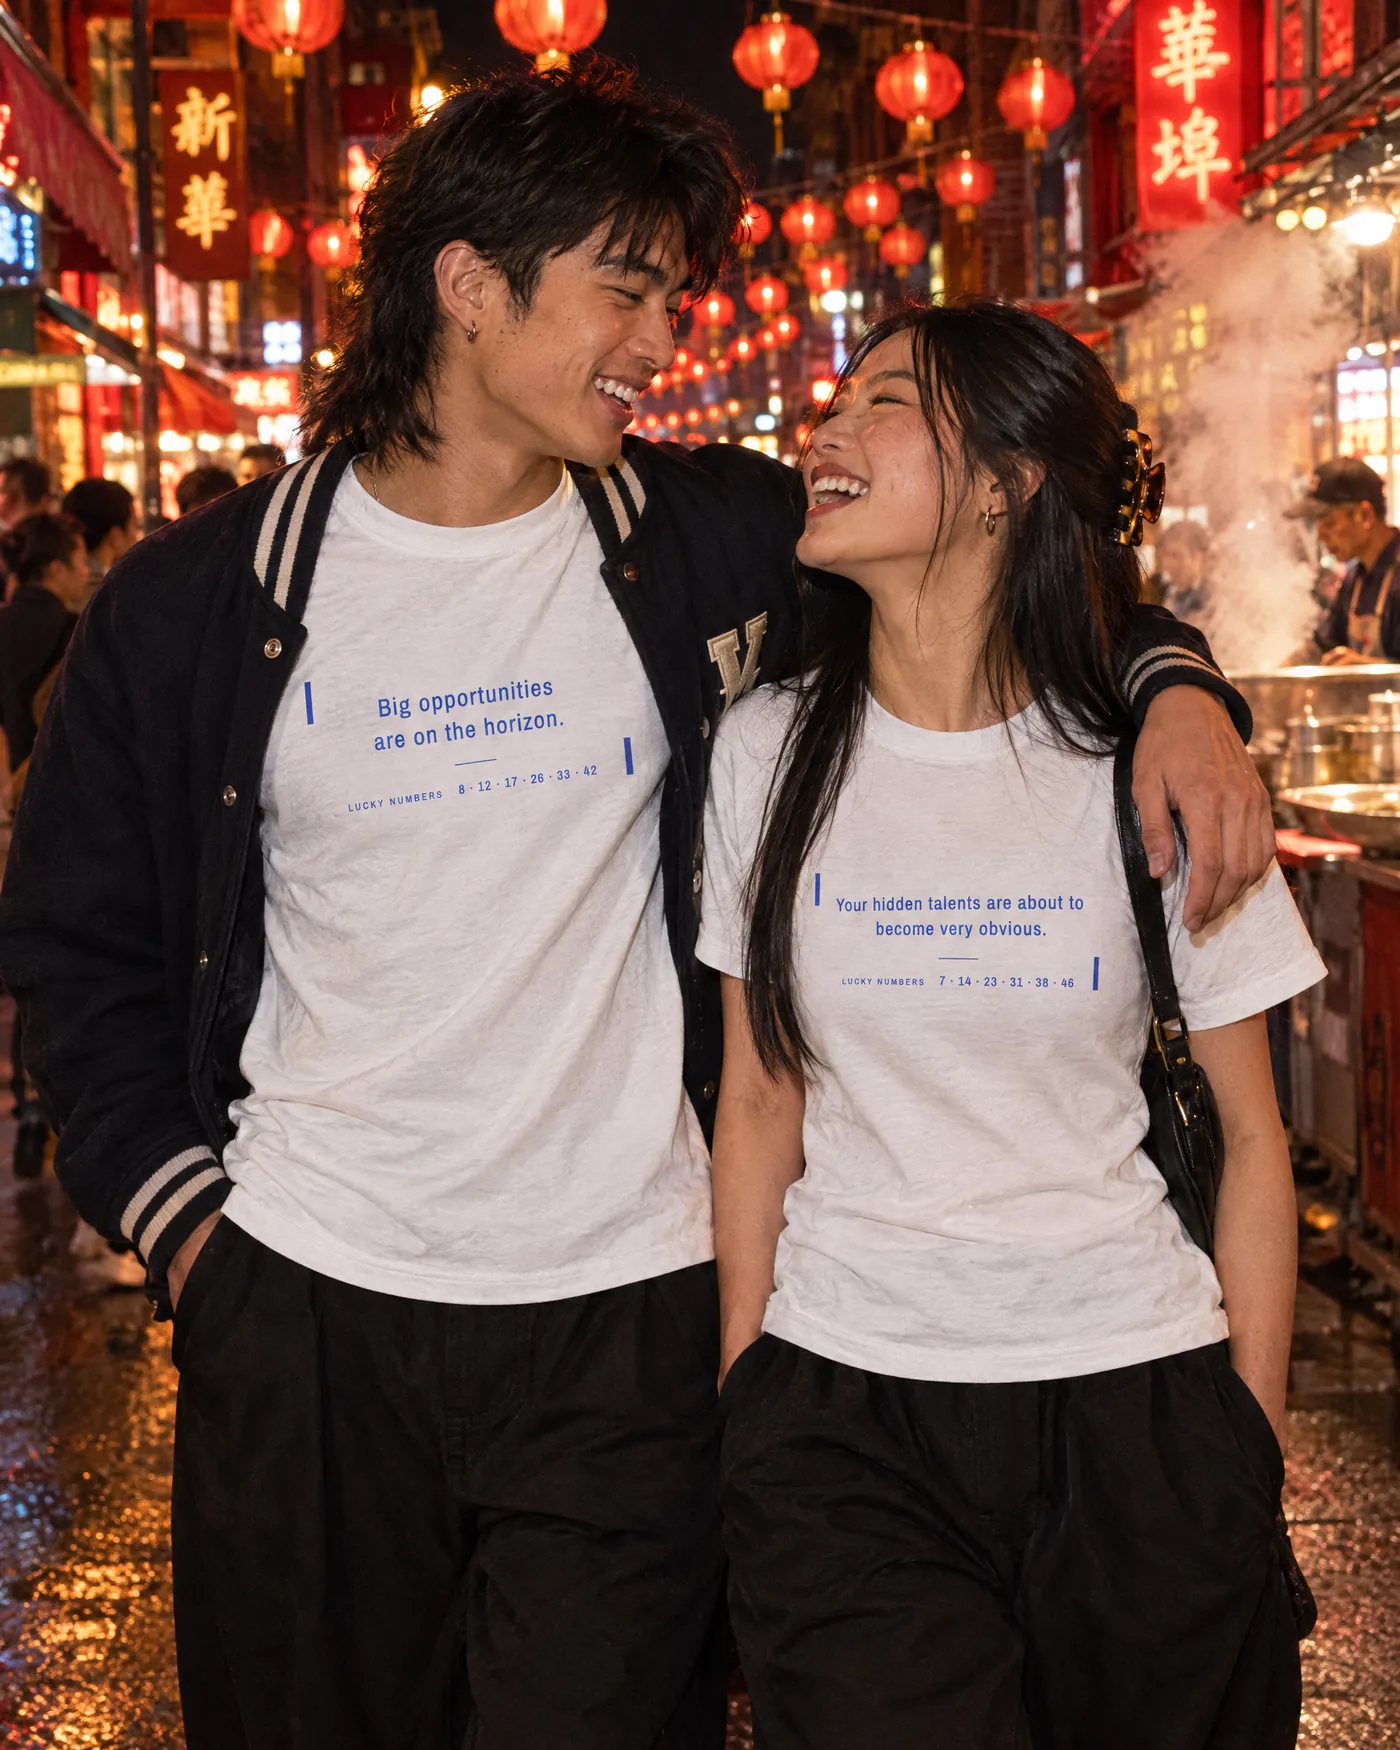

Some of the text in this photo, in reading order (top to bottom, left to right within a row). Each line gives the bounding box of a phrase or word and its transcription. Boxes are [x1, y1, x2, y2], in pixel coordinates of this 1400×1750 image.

[1151, 0, 1231, 203] 華埠
[171, 86, 238, 250] 新華
[377, 680, 553, 720] Big opportunities
[374, 712, 564, 751] are on the horizon.
[347, 765, 598, 813] LUCKY NUMBERS 8 12 17 26 33 42
[836, 895, 1085, 913] Your hidden talents are about to
[876, 921, 1047, 939] become very obvious.
[841, 975, 1075, 988] LUCKY NUMBERS 7 14 23 31 38 46
